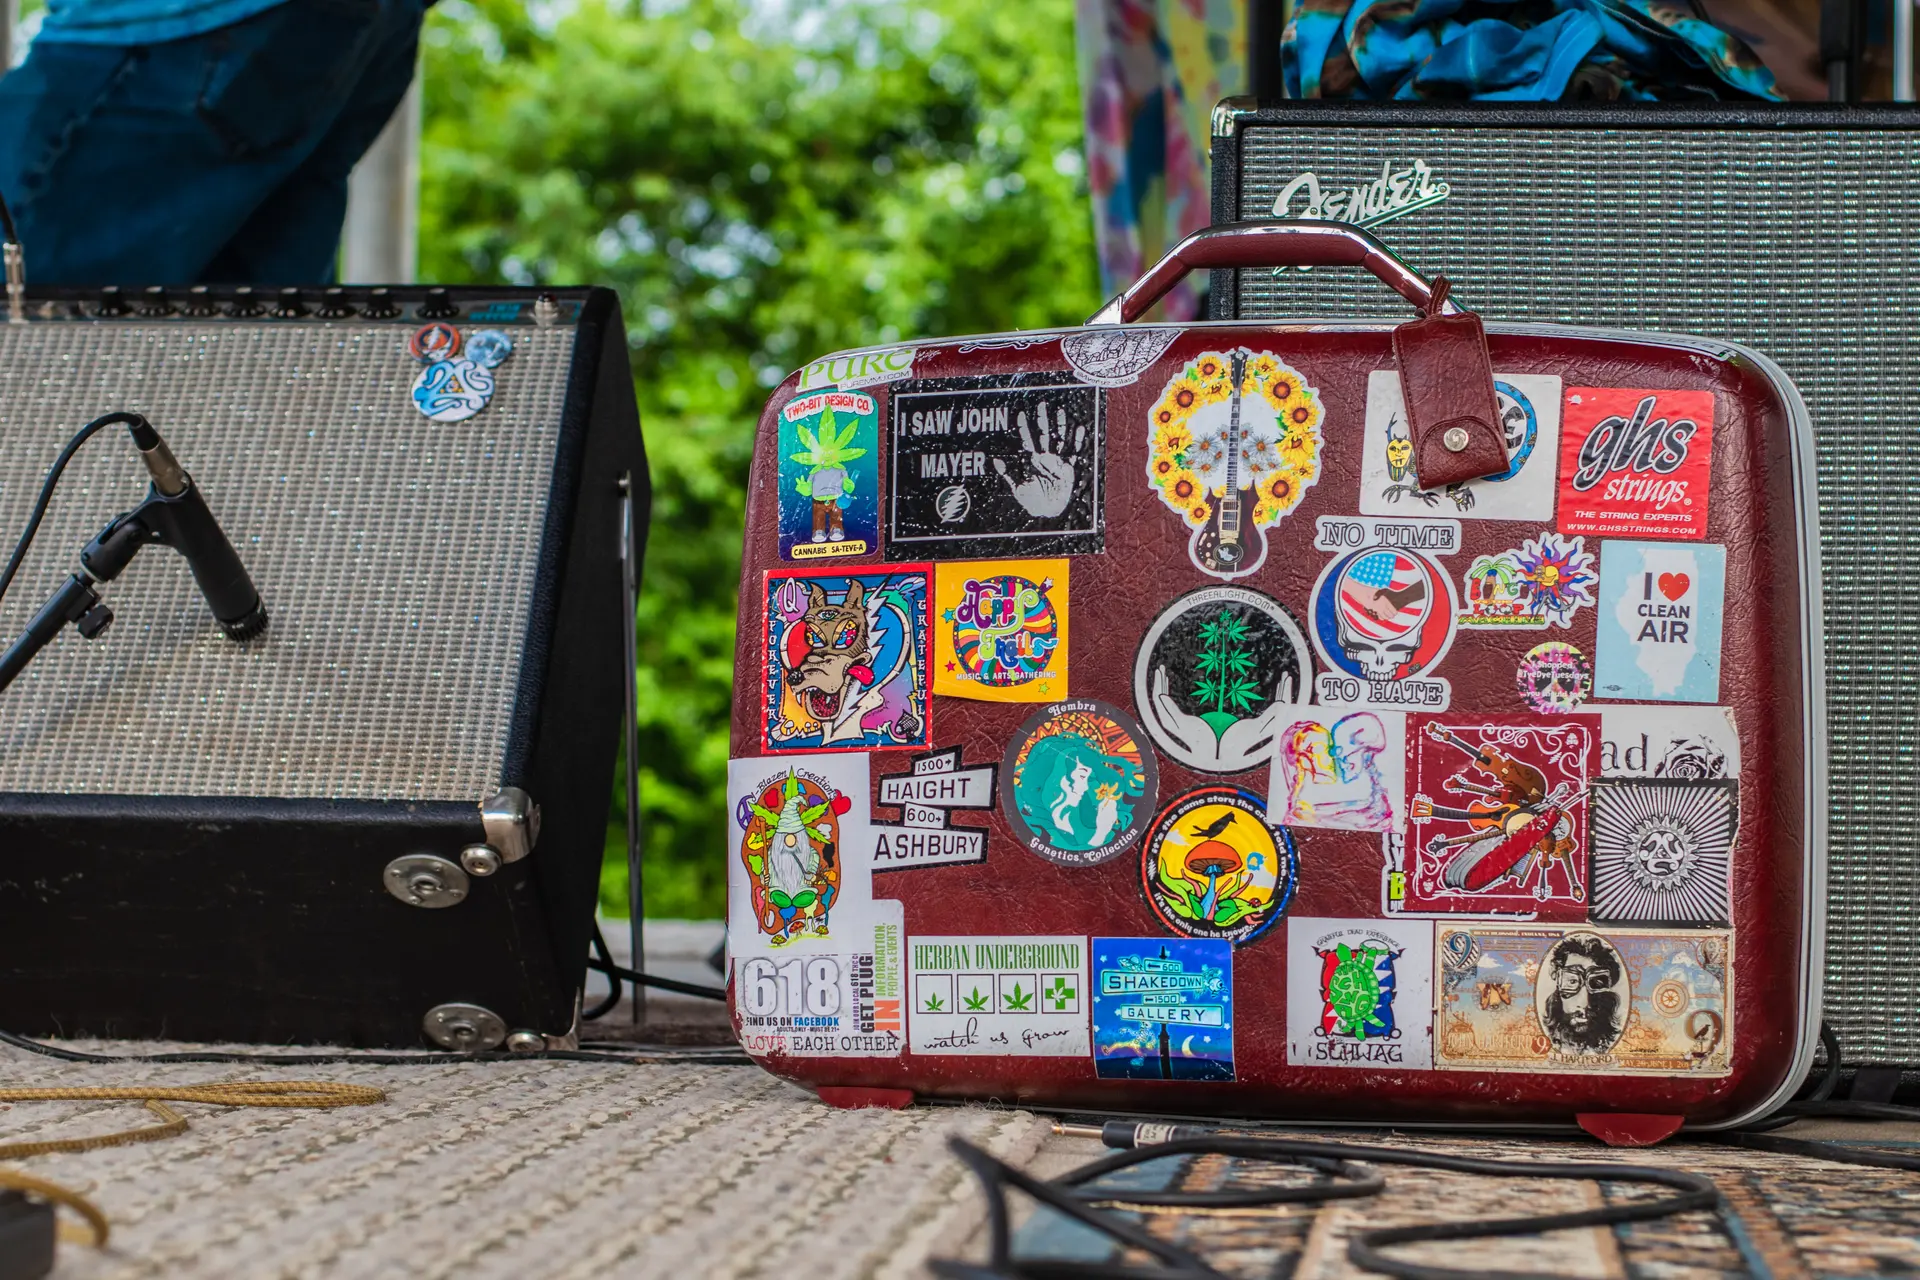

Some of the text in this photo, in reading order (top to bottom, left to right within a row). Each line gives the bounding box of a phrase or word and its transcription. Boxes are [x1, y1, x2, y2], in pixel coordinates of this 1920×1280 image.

[1272, 159, 1450, 230] Fender
[786, 394, 870, 420] TWO-BIT DESIGN CO.
[900, 407, 1008, 437] I SAW JOHN
[1572, 395, 1698, 492] ghs
[921, 451, 986, 478] MAYER
[1567, 523, 1697, 535] WWW.GHSSTRINGS.COM
[1574, 510, 1693, 522] THE STRING EXPERTS
[1321, 522, 1454, 549] NO TIME
[793, 546, 827, 556] CANNABIS
[1643, 572, 1653, 600] I
[1637, 604, 1690, 619] CLEAN
[1637, 620, 1689, 644] AIR
[767, 620, 780, 720] FOREVER
[992, 672, 1011, 680] ARTS
[1015, 671, 1057, 680] GATHERING
[1322, 678, 1444, 705] TO HATE
[1048, 701, 1097, 717] Hembra
[917, 758, 944, 772] 1500
[887, 778, 971, 800] HAIGHT
[906, 808, 935, 823] 600
[1162, 814, 1178, 831] the
[1179, 797, 1206, 816] same
[1206, 795, 1235, 806] story
[1237, 799, 1254, 811] the
[1273, 831, 1287, 858] told
[873, 833, 979, 861] ASHBURY
[1030, 828, 1139, 862] Genetics Collection
[1163, 906, 1176, 921] the
[1175, 919, 1193, 933] only
[1193, 928, 1209, 938] one
[1210, 930, 1221, 938] he
[886, 924, 897, 955] EVENTS
[1450, 933, 1473, 970] 9
[851, 960, 859, 972] THC
[915, 944, 1079, 970] HERBAN UNDERGROUND
[1162, 964, 1180, 972] 600
[743, 957, 841, 1017] 618
[850, 973, 859, 987] 618
[1109, 975, 1202, 990] SHAKEDOWN
[1154, 996, 1177, 1004] 1500
[746, 1017, 840, 1026] FIND US ON FACEBOOK
[859, 1003, 875, 1033] GET
[874, 1000, 901, 1031] IN
[1128, 1008, 1205, 1022] GALLERY
[746, 1035, 899, 1051] LOVE EACH OTHER
[923, 1016, 979, 1049] watch
[990, 1032, 1009, 1044] us
[1316, 1042, 1403, 1064] SCHWAG
